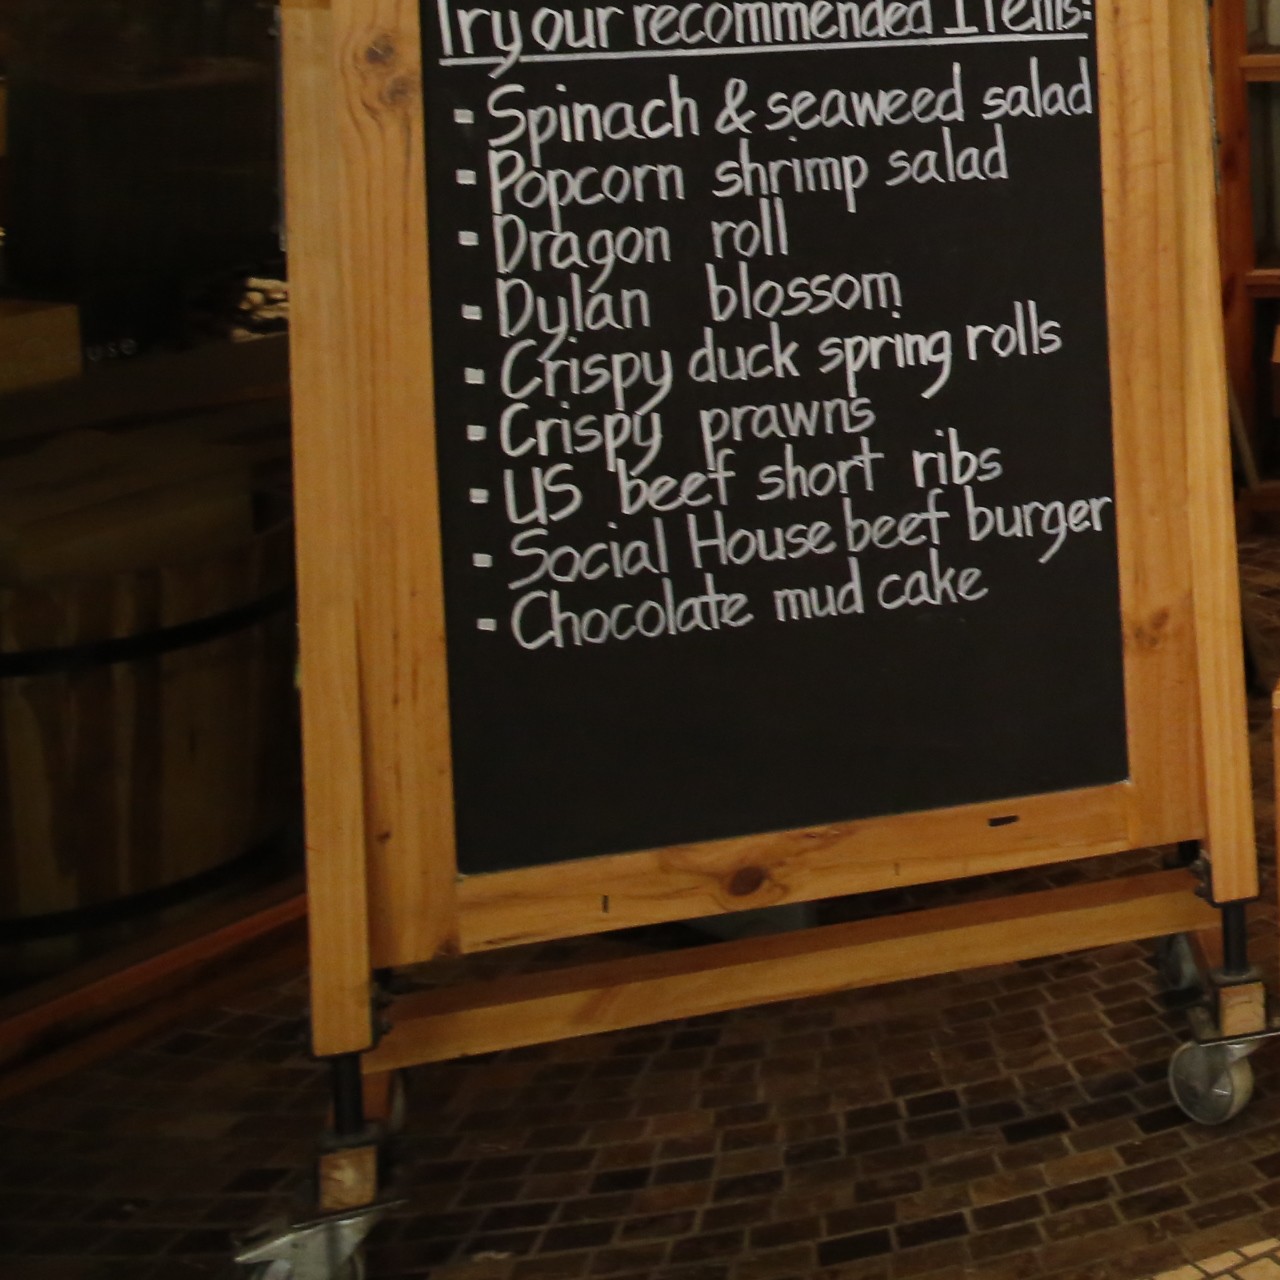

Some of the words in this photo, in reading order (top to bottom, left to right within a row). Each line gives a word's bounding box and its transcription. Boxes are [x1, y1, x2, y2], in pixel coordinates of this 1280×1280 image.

[531, 5, 625, 51] our
[486, 74, 699, 168] Spinach
[714, 77, 757, 135] &
[766, 62, 964, 132] seaweed
[981, 55, 1093, 120] salad
[487, 147, 686, 235] Popcorn
[711, 135, 868, 214] shrimp
[885, 124, 1009, 186] salad
[494, 212, 672, 293] Dragon
[711, 197, 789, 258] roll
[495, 273, 651, 363] Dylan
[706, 261, 902, 322] blossom
[500, 336, 673, 416] Crispy
[688, 320, 801, 383] duck
[818, 314, 952, 400] spring
[965, 299, 1063, 360] rolls
[500, 399, 663, 477] Crispy
[699, 394, 876, 472] prawns
[503, 462, 584, 526] US
[616, 449, 736, 516] beef
[756, 436, 885, 501] short
[912, 426, 1003, 489] ribs
[508, 517, 669, 590] Social
[687, 513, 837, 570] House
[844, 490, 951, 553] beef
[965, 486, 1112, 565] burger
[510, 578, 754, 652] Chocolate
[774, 556, 865, 624] mud
[876, 548, 989, 611] cake
